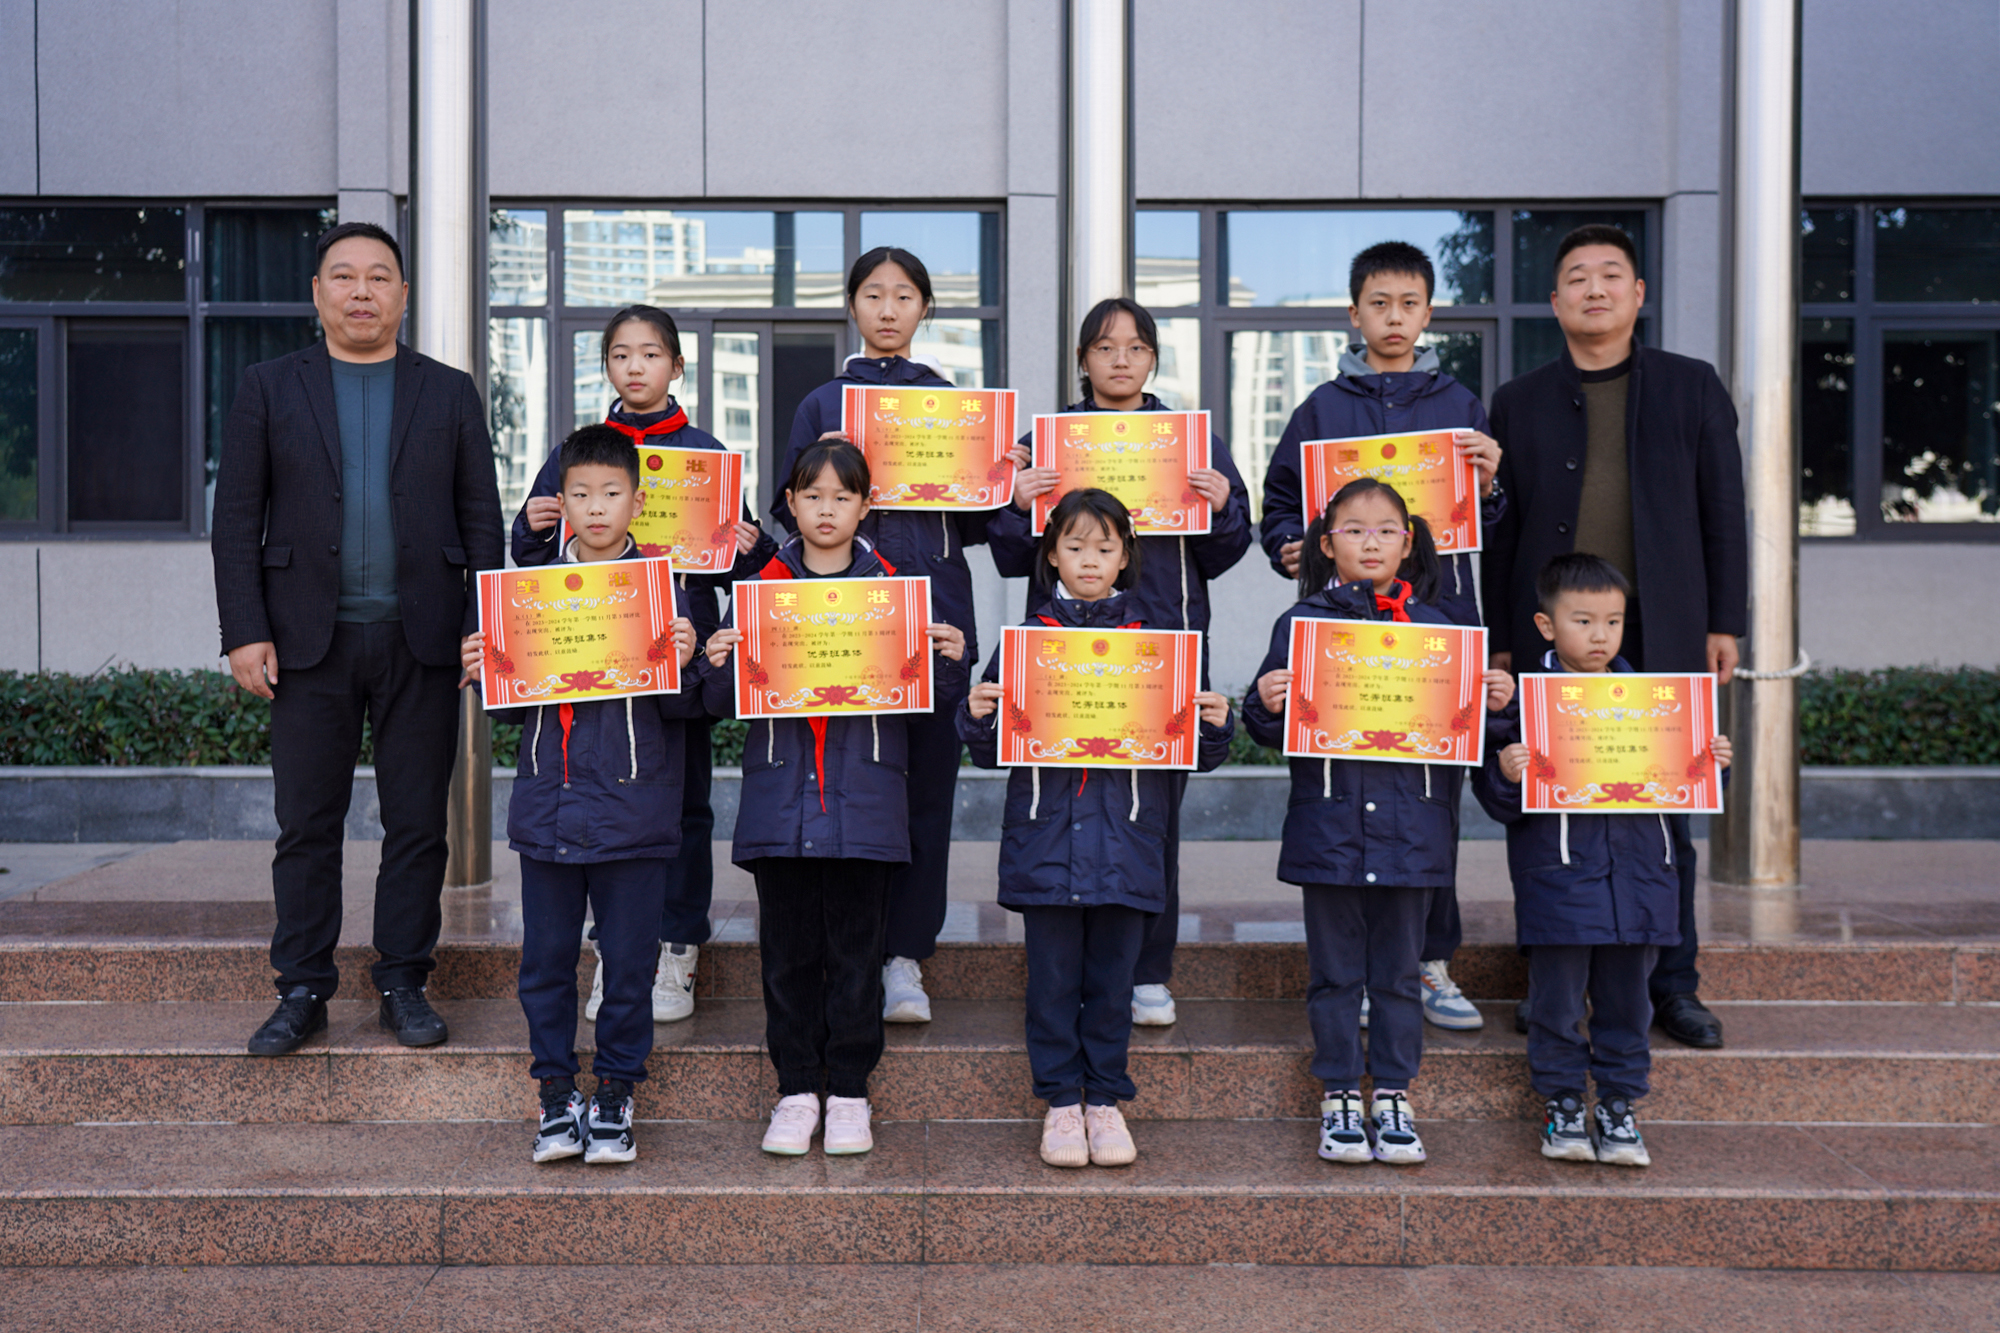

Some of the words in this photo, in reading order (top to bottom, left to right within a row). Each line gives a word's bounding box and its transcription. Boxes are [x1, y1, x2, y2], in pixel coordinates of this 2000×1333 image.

[906, 450, 955, 458] 优秀班集体
[608, 571, 633, 588] 状
[867, 590, 891, 604] 状
[551, 633, 608, 645] 优秀班集体
[807, 649, 862, 659] 优秀班集体
[1135, 641, 1159, 657] 状
[1359, 693, 1414, 703] 优秀班集体
[1072, 700, 1128, 709] 优秀班集体
